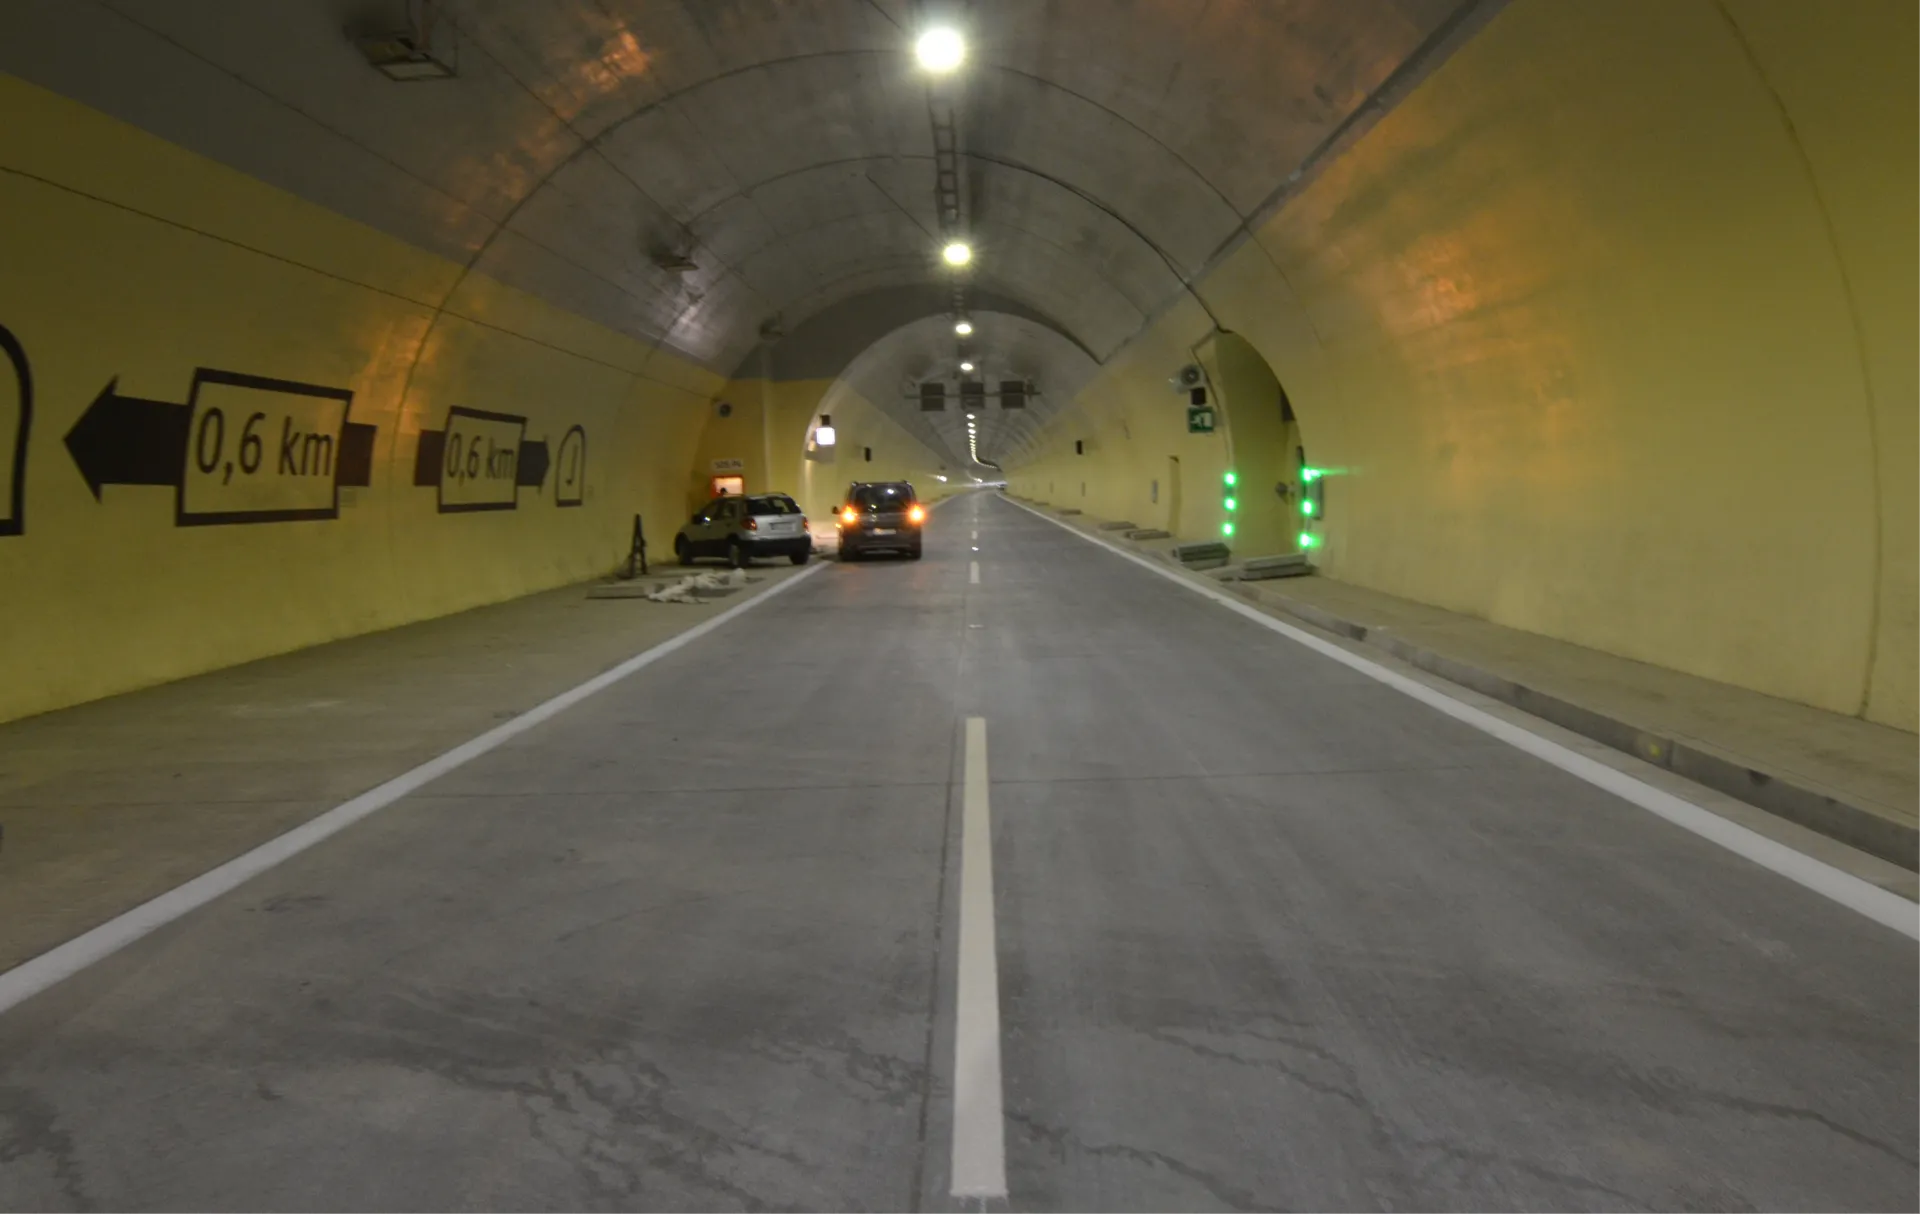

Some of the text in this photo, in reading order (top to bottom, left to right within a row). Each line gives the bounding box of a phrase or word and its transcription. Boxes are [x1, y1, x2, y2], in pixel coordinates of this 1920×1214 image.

[197, 407, 332, 485] 0,6 km
[447, 432, 516, 487] 0,6 km
